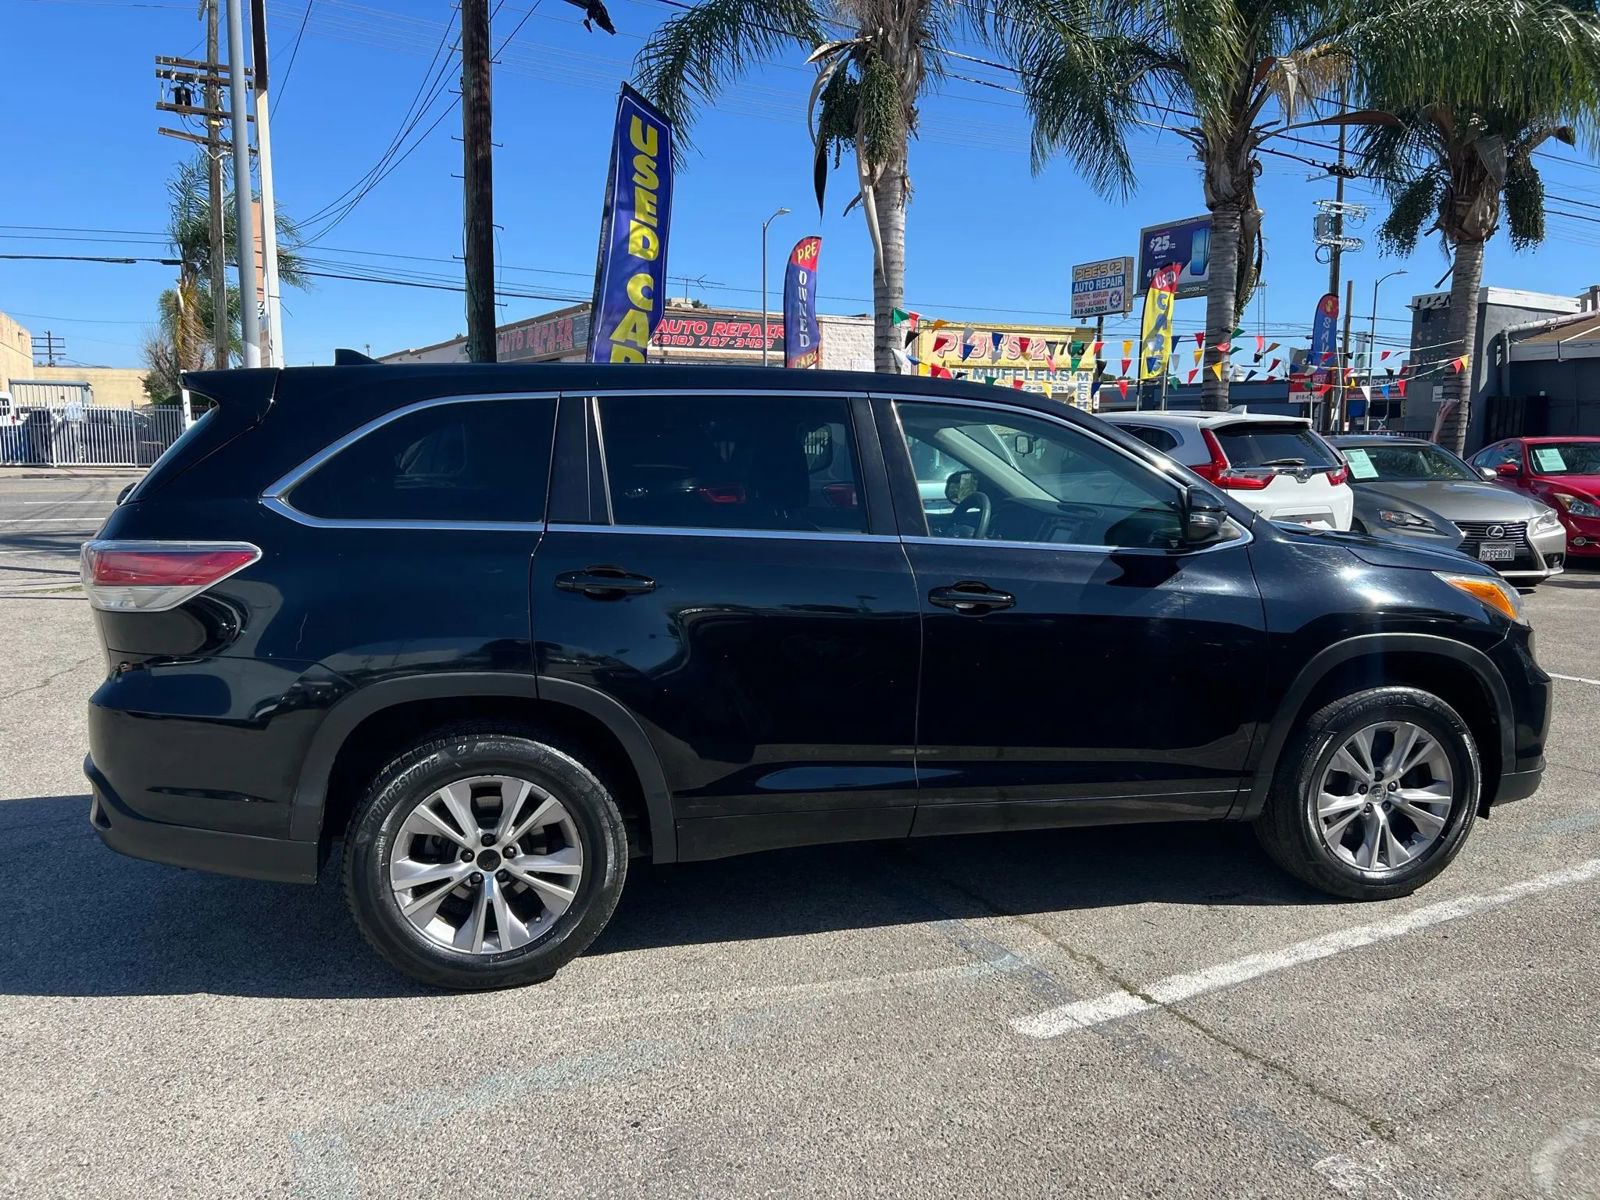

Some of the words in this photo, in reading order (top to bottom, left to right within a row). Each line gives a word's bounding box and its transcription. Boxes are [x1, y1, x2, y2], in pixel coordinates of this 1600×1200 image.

[628, 114, 660, 262] USED
[797, 241, 818, 264] PRE
[1074, 281, 1095, 293] AUTO
[1096, 276, 1123, 290] REPAIR
[1155, 271, 1176, 289] USED
[798, 270, 811, 348] OWNED
[654, 319, 708, 335] AUTO
[711, 321, 785, 339] REPAIR
[652, 333, 696, 346] (818)
[973, 367, 1070, 382] MUFFLERS
[363, 753, 441, 828] RIDGESTONE
